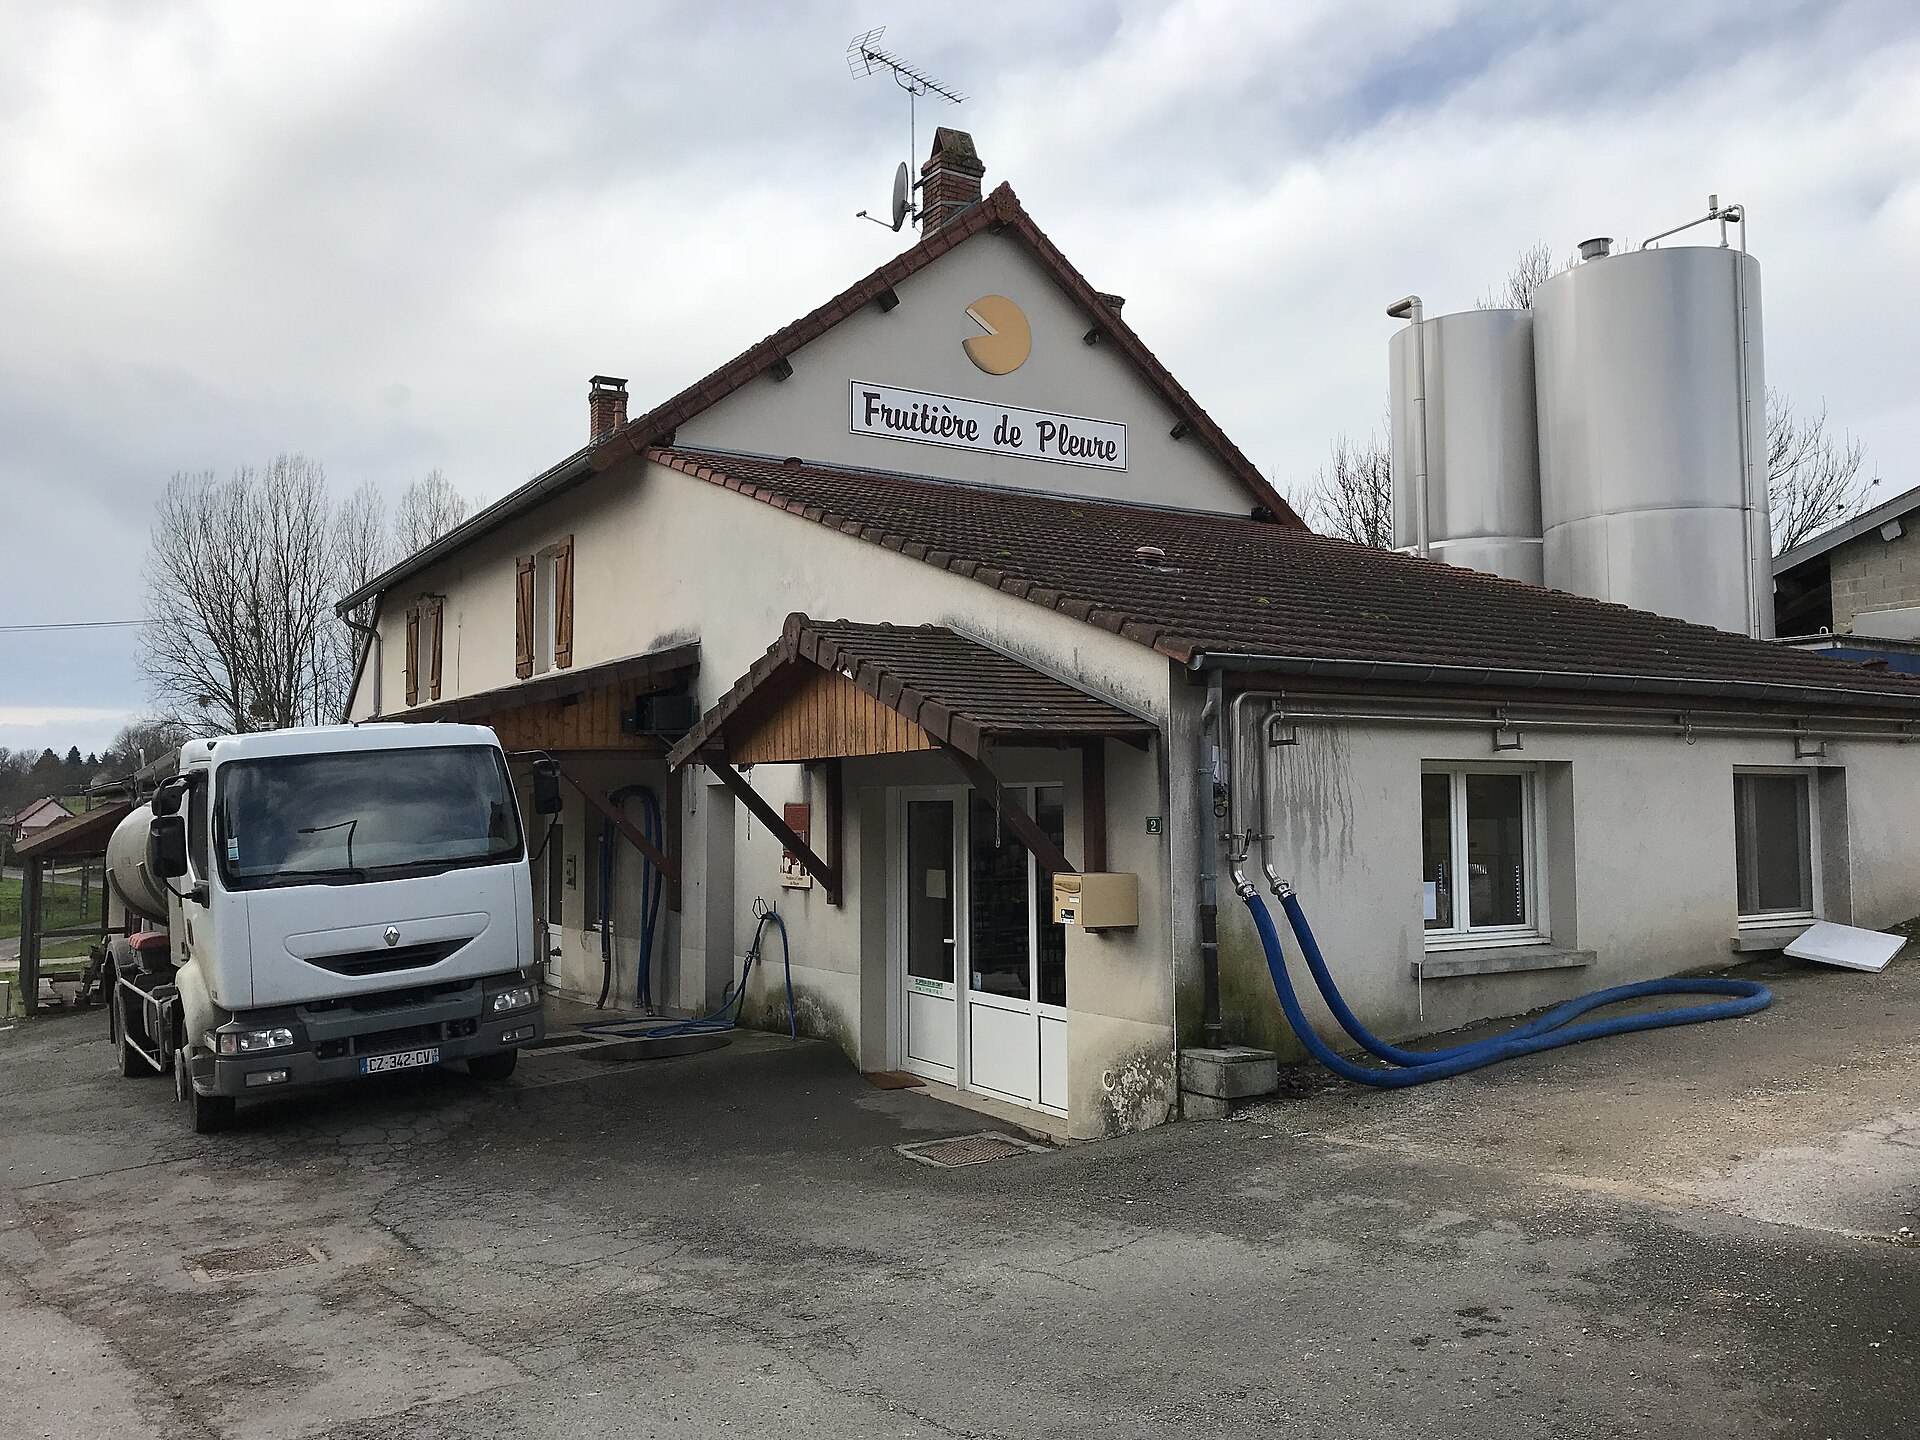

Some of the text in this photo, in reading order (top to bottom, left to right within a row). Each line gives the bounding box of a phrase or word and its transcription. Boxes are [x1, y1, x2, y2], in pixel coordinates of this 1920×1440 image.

[862, 391, 1118, 462] Fruitière de Pleure
[1150, 819, 1157, 831] 2
[369, 1051, 430, 1072] CZ-342-CV
